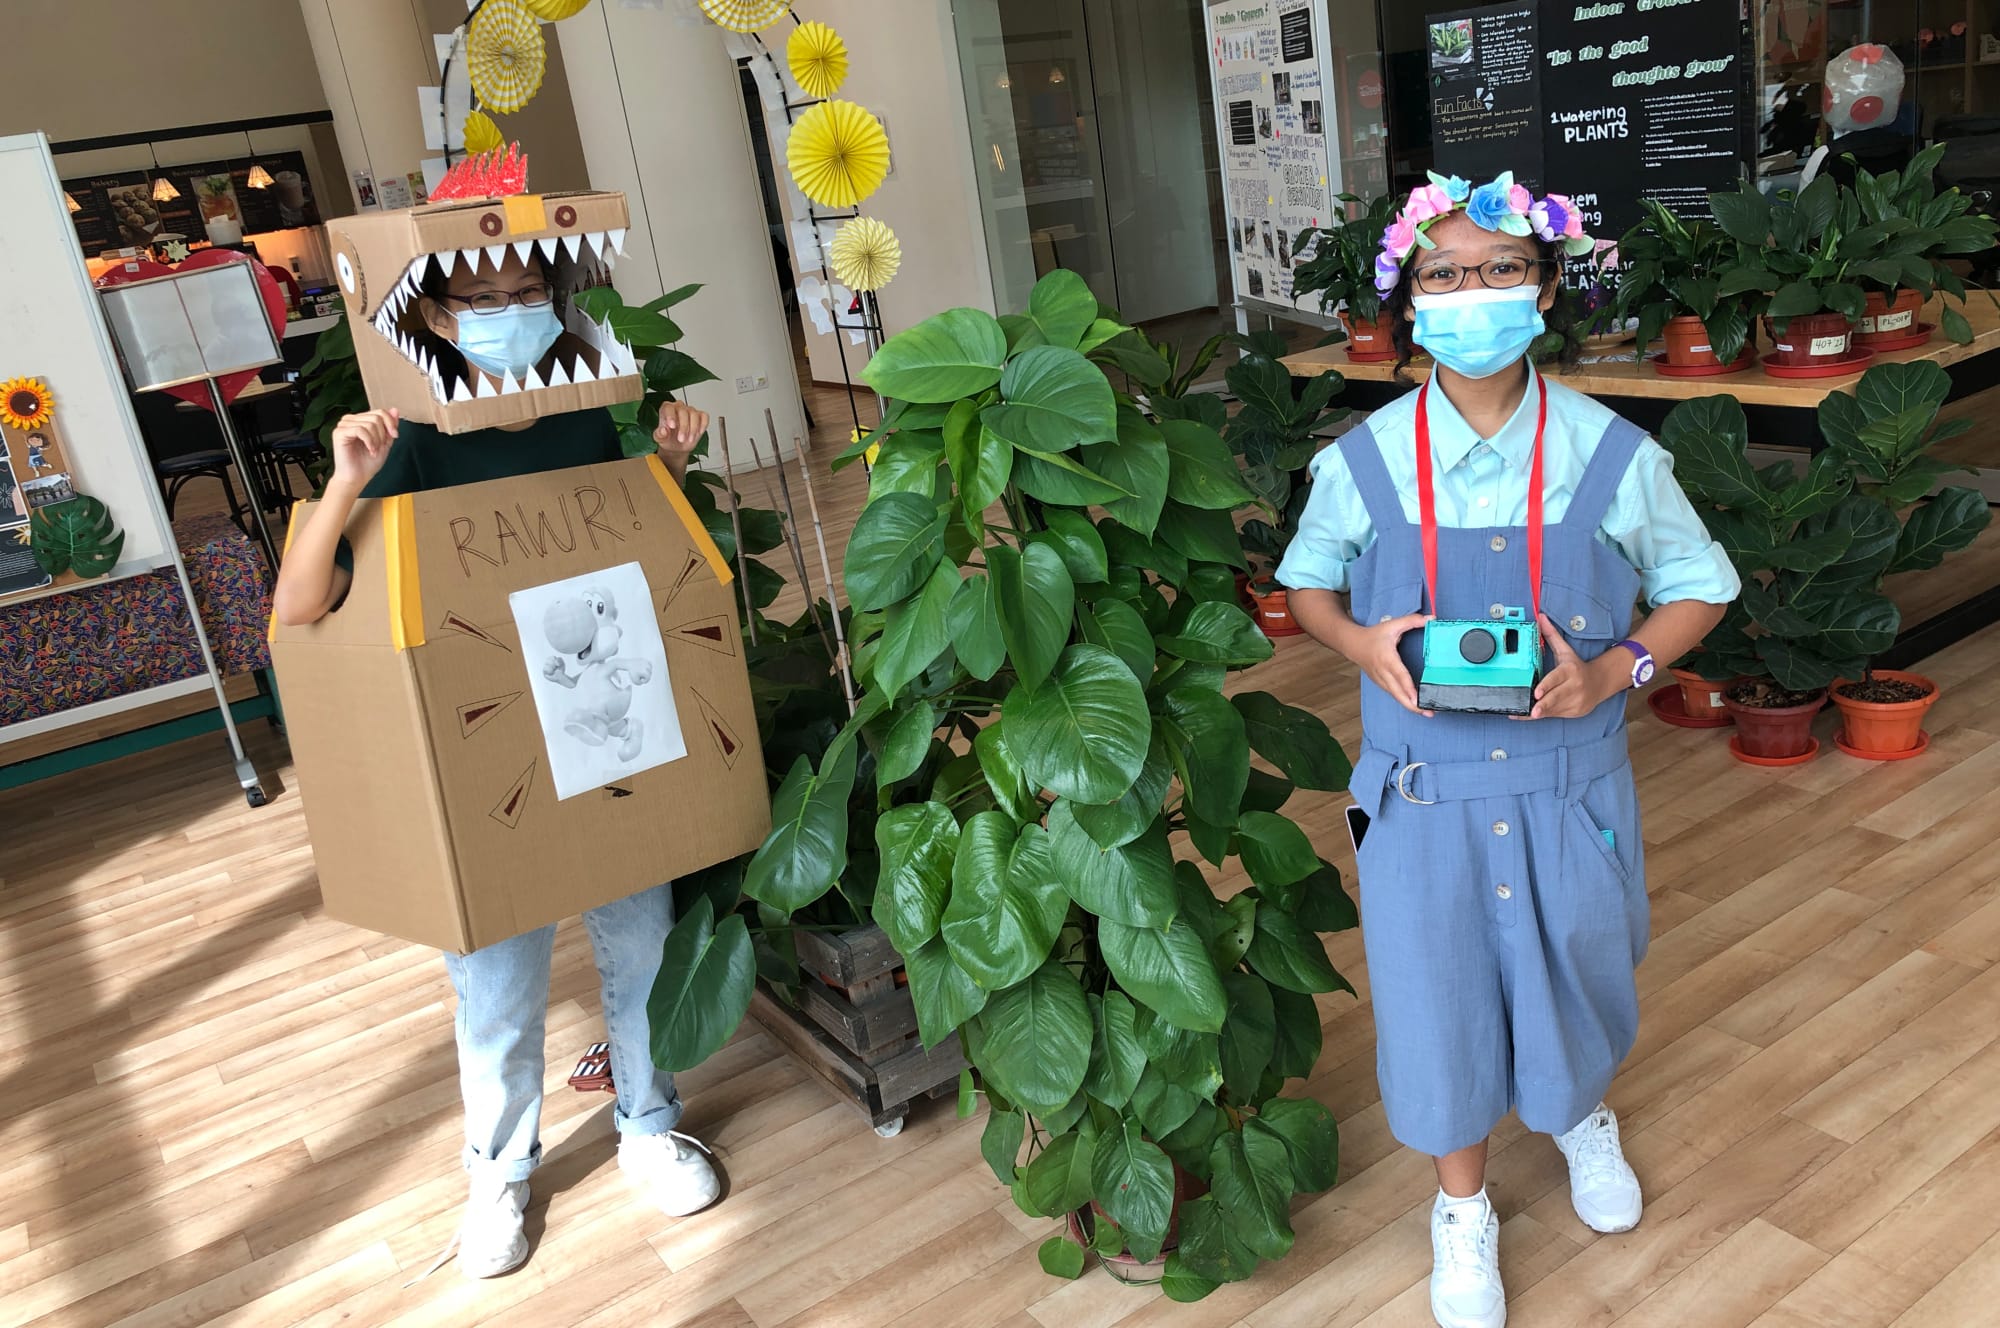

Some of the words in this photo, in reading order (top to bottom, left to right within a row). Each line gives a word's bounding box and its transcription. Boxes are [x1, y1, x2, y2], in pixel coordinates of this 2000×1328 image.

[1573, 2, 1626, 21] Indoor
[1578, 45, 1604, 62] the
[1608, 36, 1649, 60] good
[1612, 65, 1680, 87] thoughts
[1434, 98, 1454, 115] Fun
[1456, 94, 1483, 112] Facts
[1564, 121, 1628, 143] PLANTS
[450, 478, 642, 578] RAWR!
